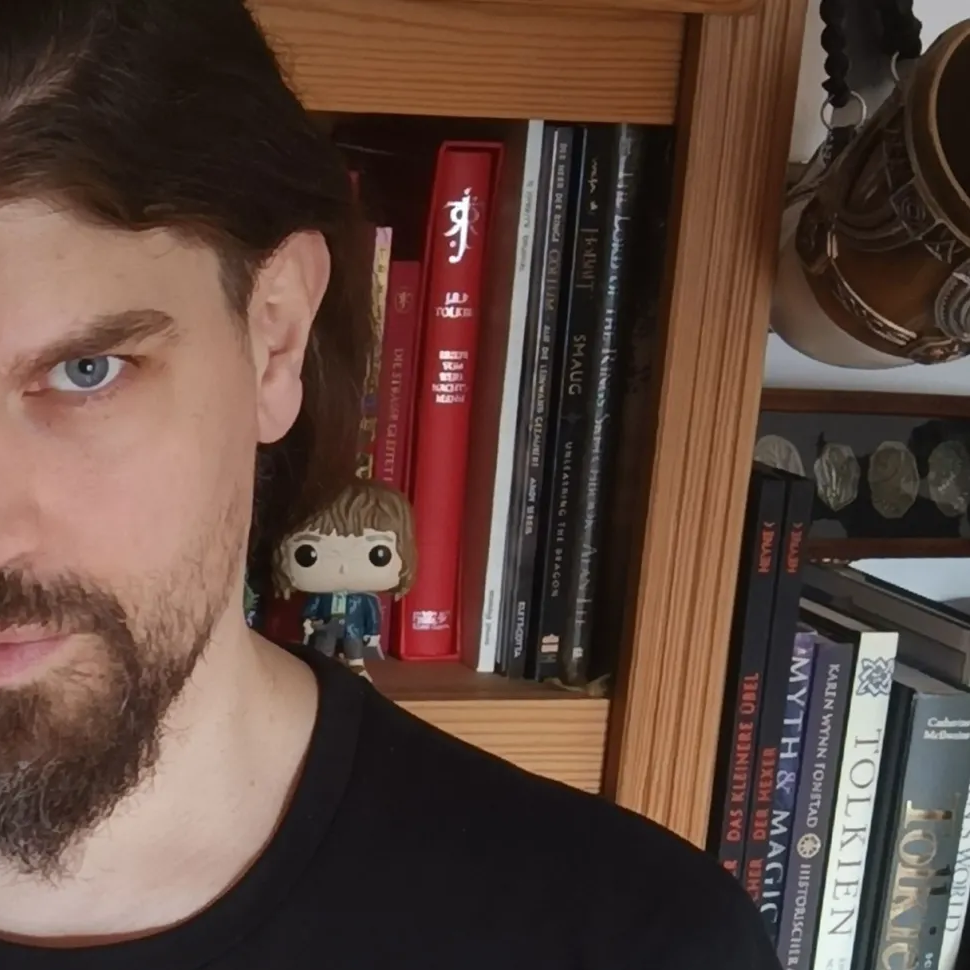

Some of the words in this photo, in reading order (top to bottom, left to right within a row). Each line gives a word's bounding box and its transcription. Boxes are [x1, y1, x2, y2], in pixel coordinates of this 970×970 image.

[567, 333, 587, 396] SMAUG
[555, 520, 567, 543] THE
[781, 655, 812, 760] MYTH
[822, 663, 841, 711] KAREN
[730, 721, 754, 803] KLEINERE
[816, 712, 834, 759] WYNN
[756, 747, 778, 802] HEXER
[775, 768, 797, 796] &
[805, 763, 826, 829] FONSTAD
[726, 808, 744, 843] DAS
[752, 808, 770, 842] DER
[827, 727, 883, 938] TOLKIEN
[758, 808, 790, 929] MAGIC
[786, 863, 812, 966] HISTORISCHER
